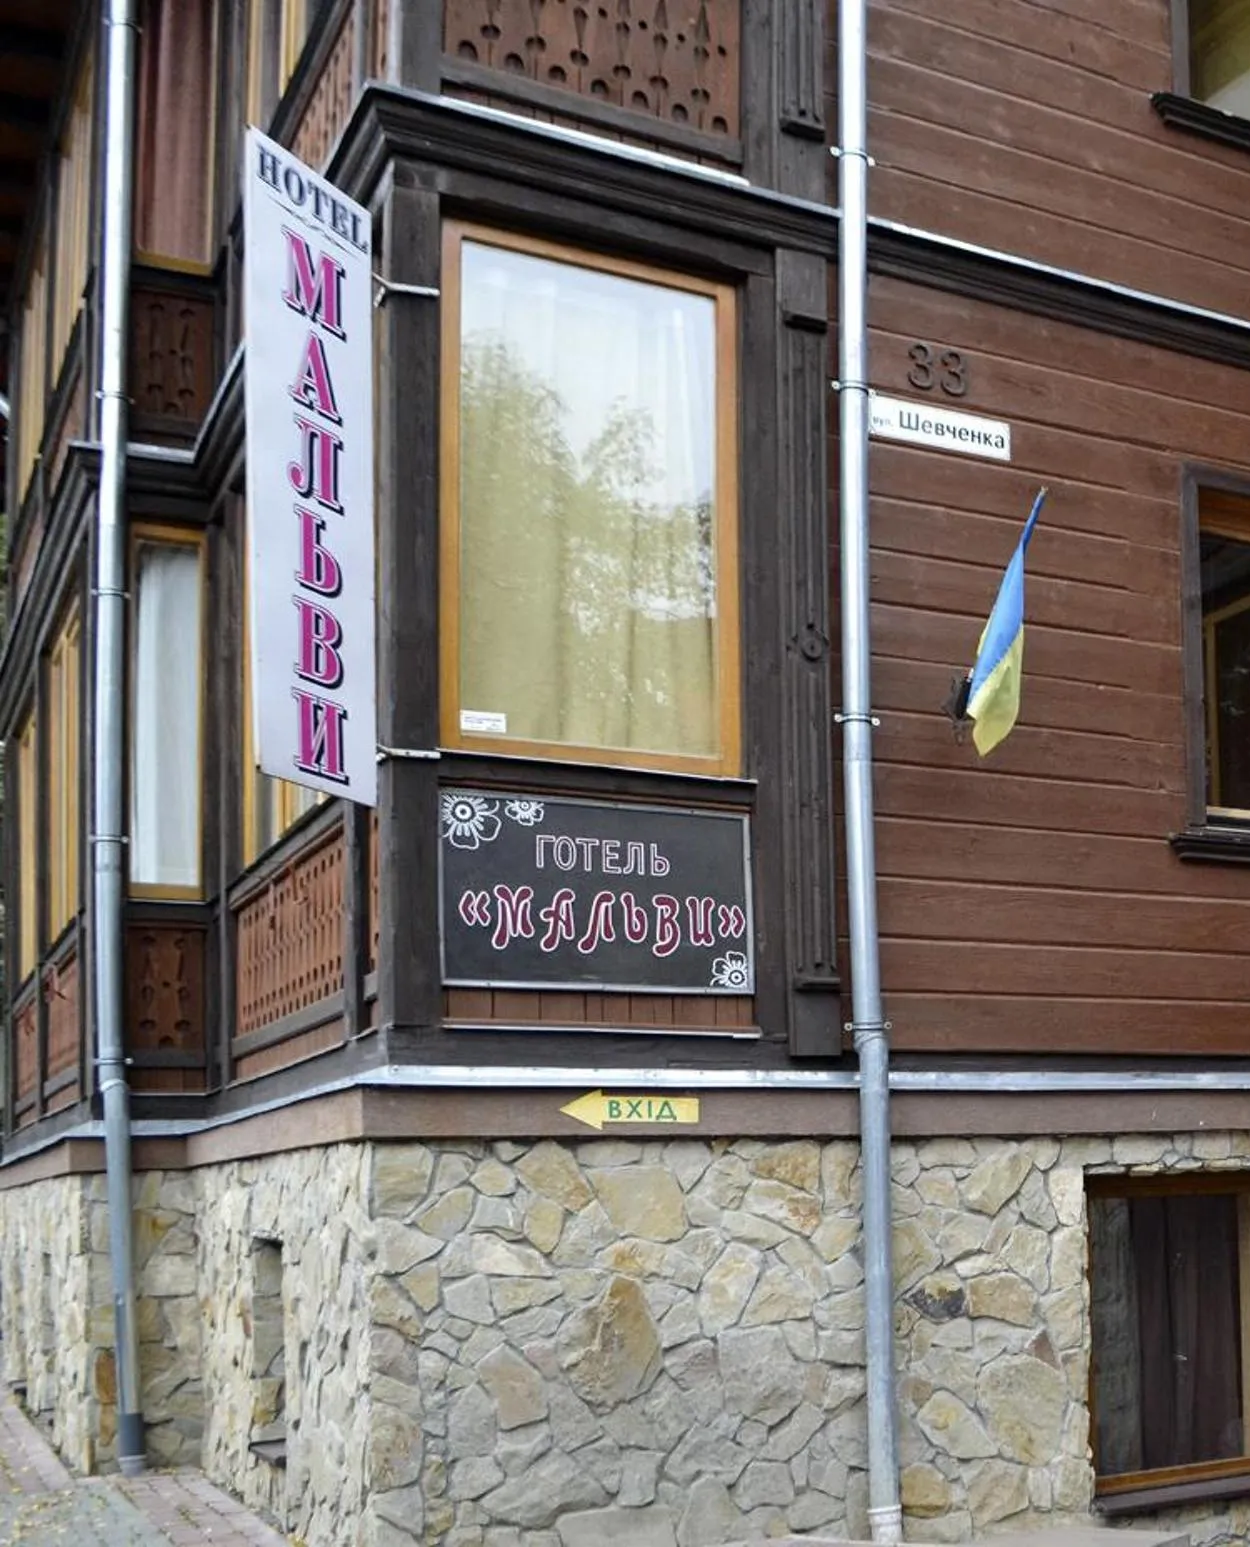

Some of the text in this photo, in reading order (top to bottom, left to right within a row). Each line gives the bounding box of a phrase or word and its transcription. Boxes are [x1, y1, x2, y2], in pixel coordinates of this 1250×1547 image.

[257, 141, 369, 254] HOTEL
[907, 343, 968, 397] 33
[899, 410, 1005, 449] Шевченка
[281, 225, 349, 785] МАЛЬВИ
[535, 834, 671, 877] ГОТЕЛЬ
[608, 1099, 677, 1121] ВХІД
